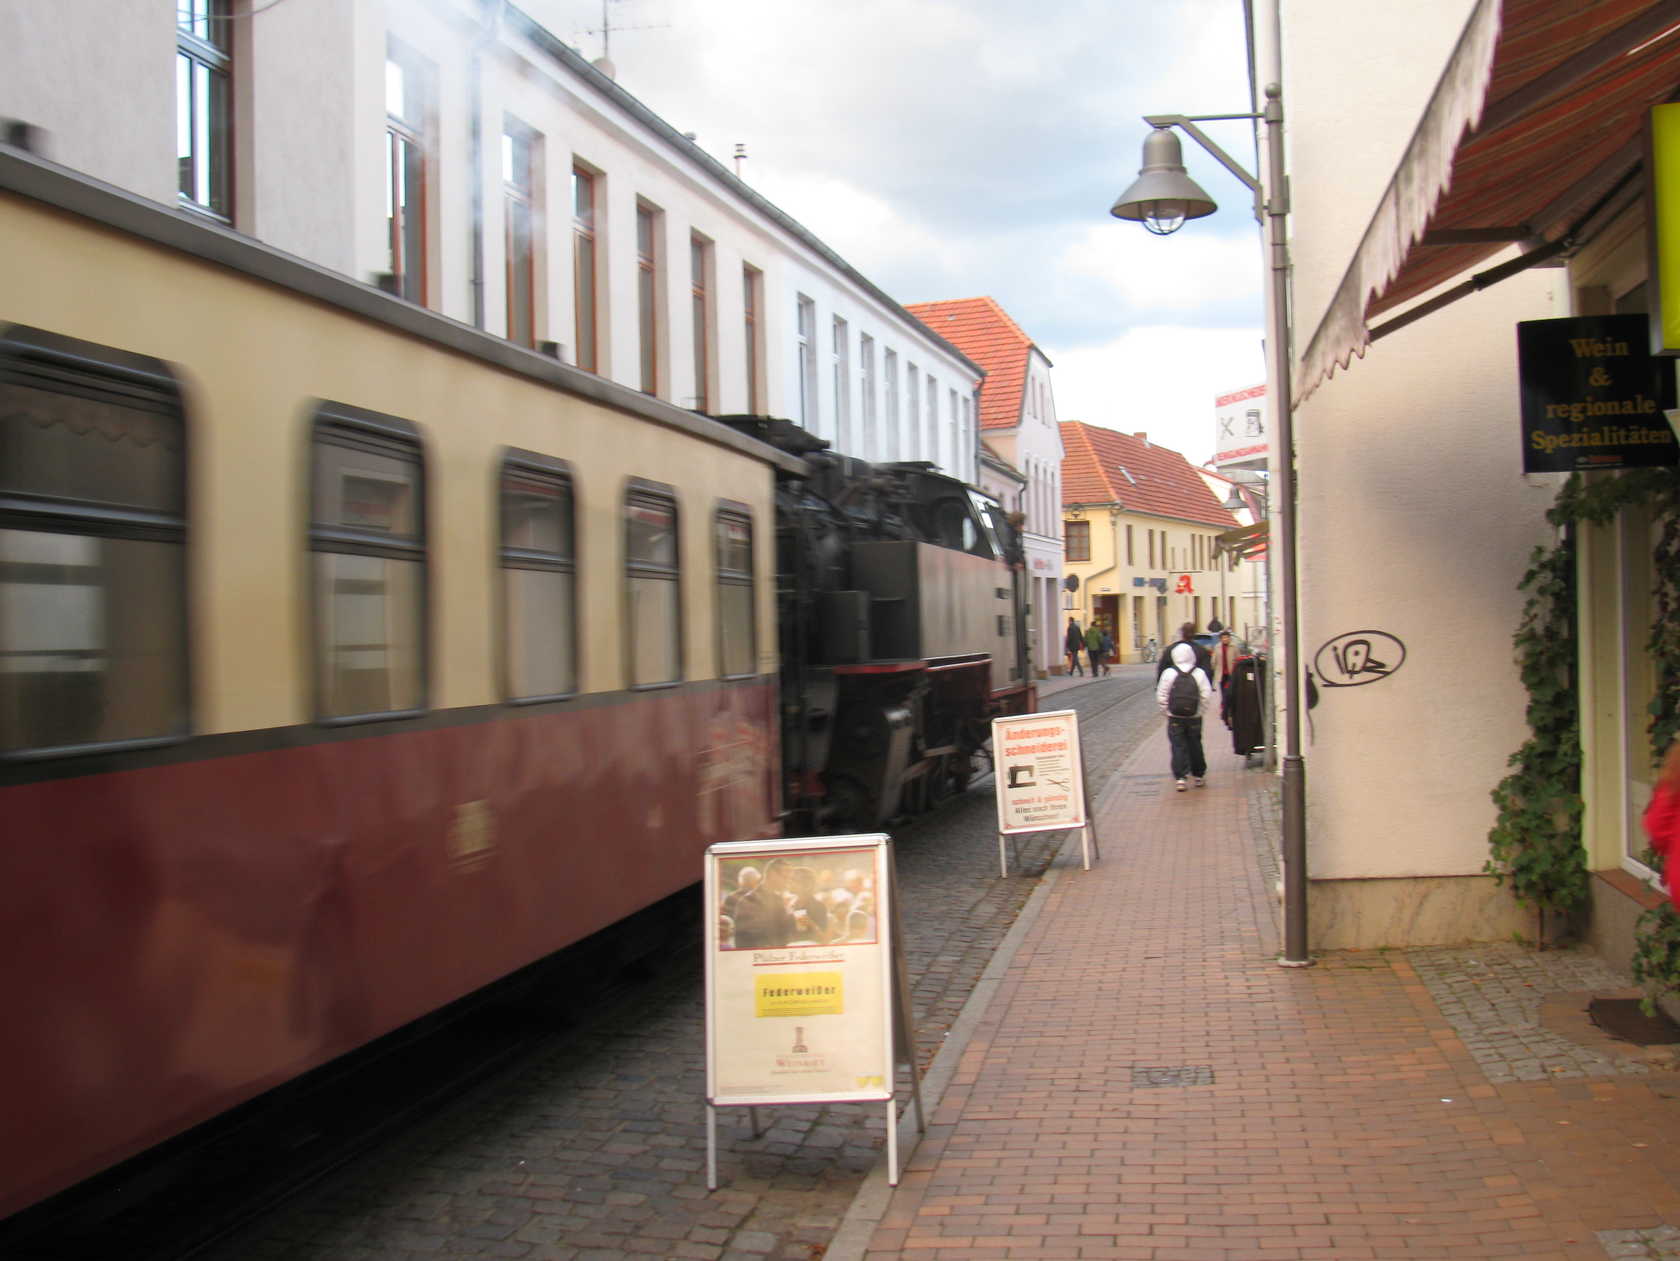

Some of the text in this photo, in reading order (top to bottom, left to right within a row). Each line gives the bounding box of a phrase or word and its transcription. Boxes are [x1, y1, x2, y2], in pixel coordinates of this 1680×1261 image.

[1568, 337, 1630, 358] Wein
[1589, 367, 1613, 386] &
[1545, 395, 1656, 422] regionale
[1531, 425, 1671, 454] Spezialitäten
